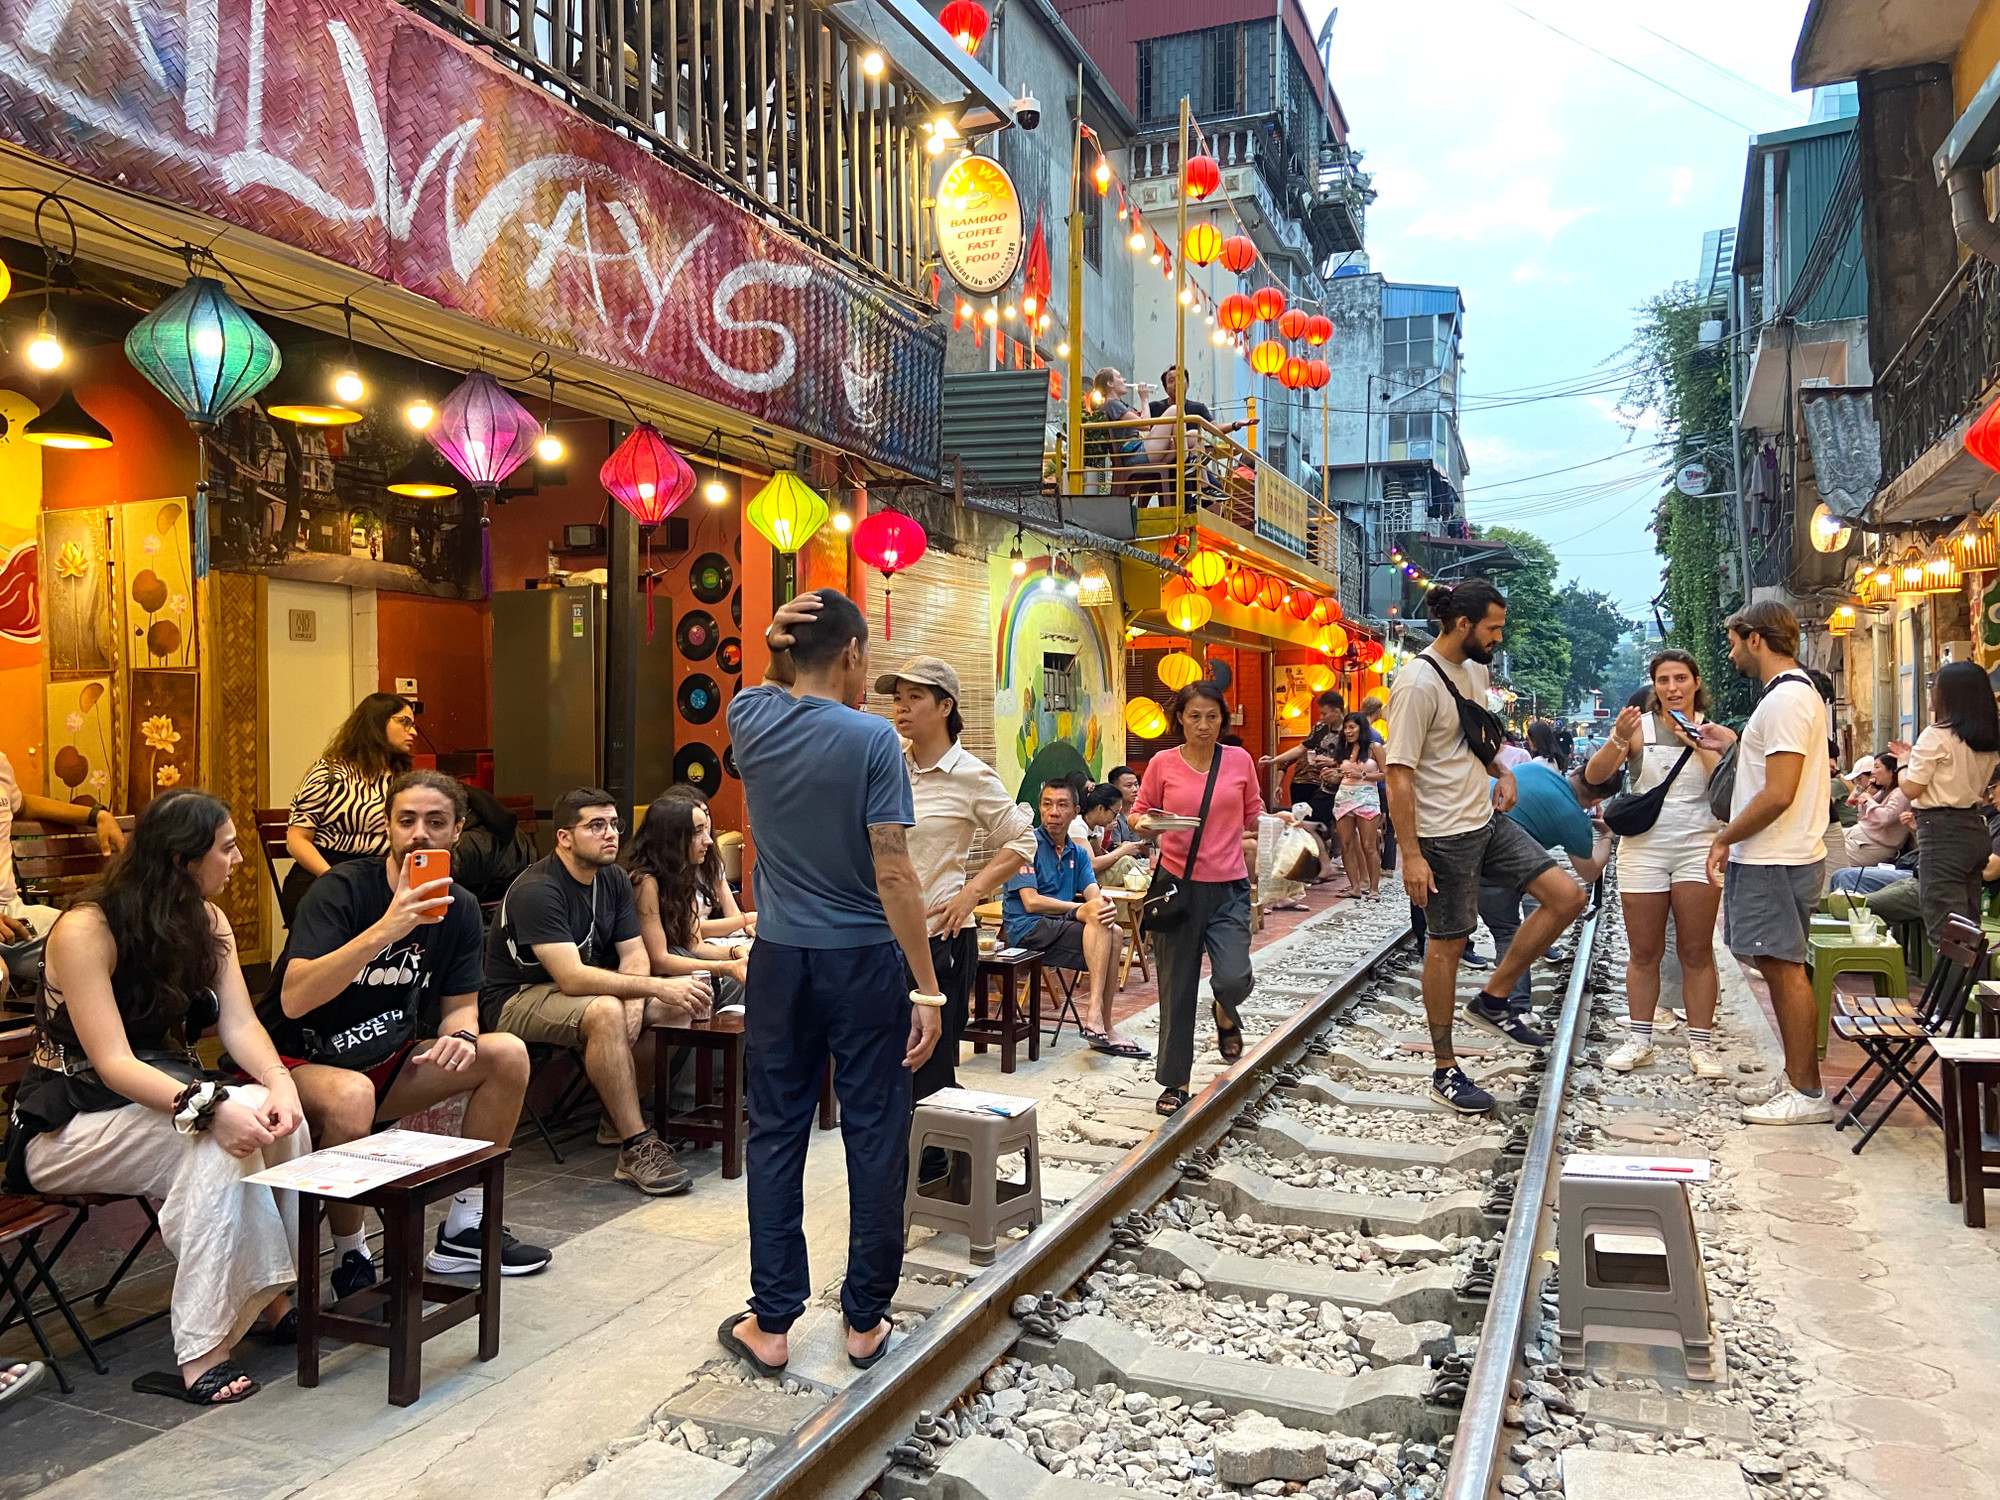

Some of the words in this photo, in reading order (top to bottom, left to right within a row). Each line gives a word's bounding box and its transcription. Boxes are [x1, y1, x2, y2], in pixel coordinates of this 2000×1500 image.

[978, 164, 1010, 198] WAY
[951, 213, 1007, 227] BAMBOO
[957, 226, 1003, 239] COFFEE
[967, 239, 997, 251] FAST
[965, 252, 1000, 263] FOOD
[1496, 1020, 1517, 1031] N
[332, 1022, 387, 1053] FACE
[1443, 1085, 1458, 1100] N
